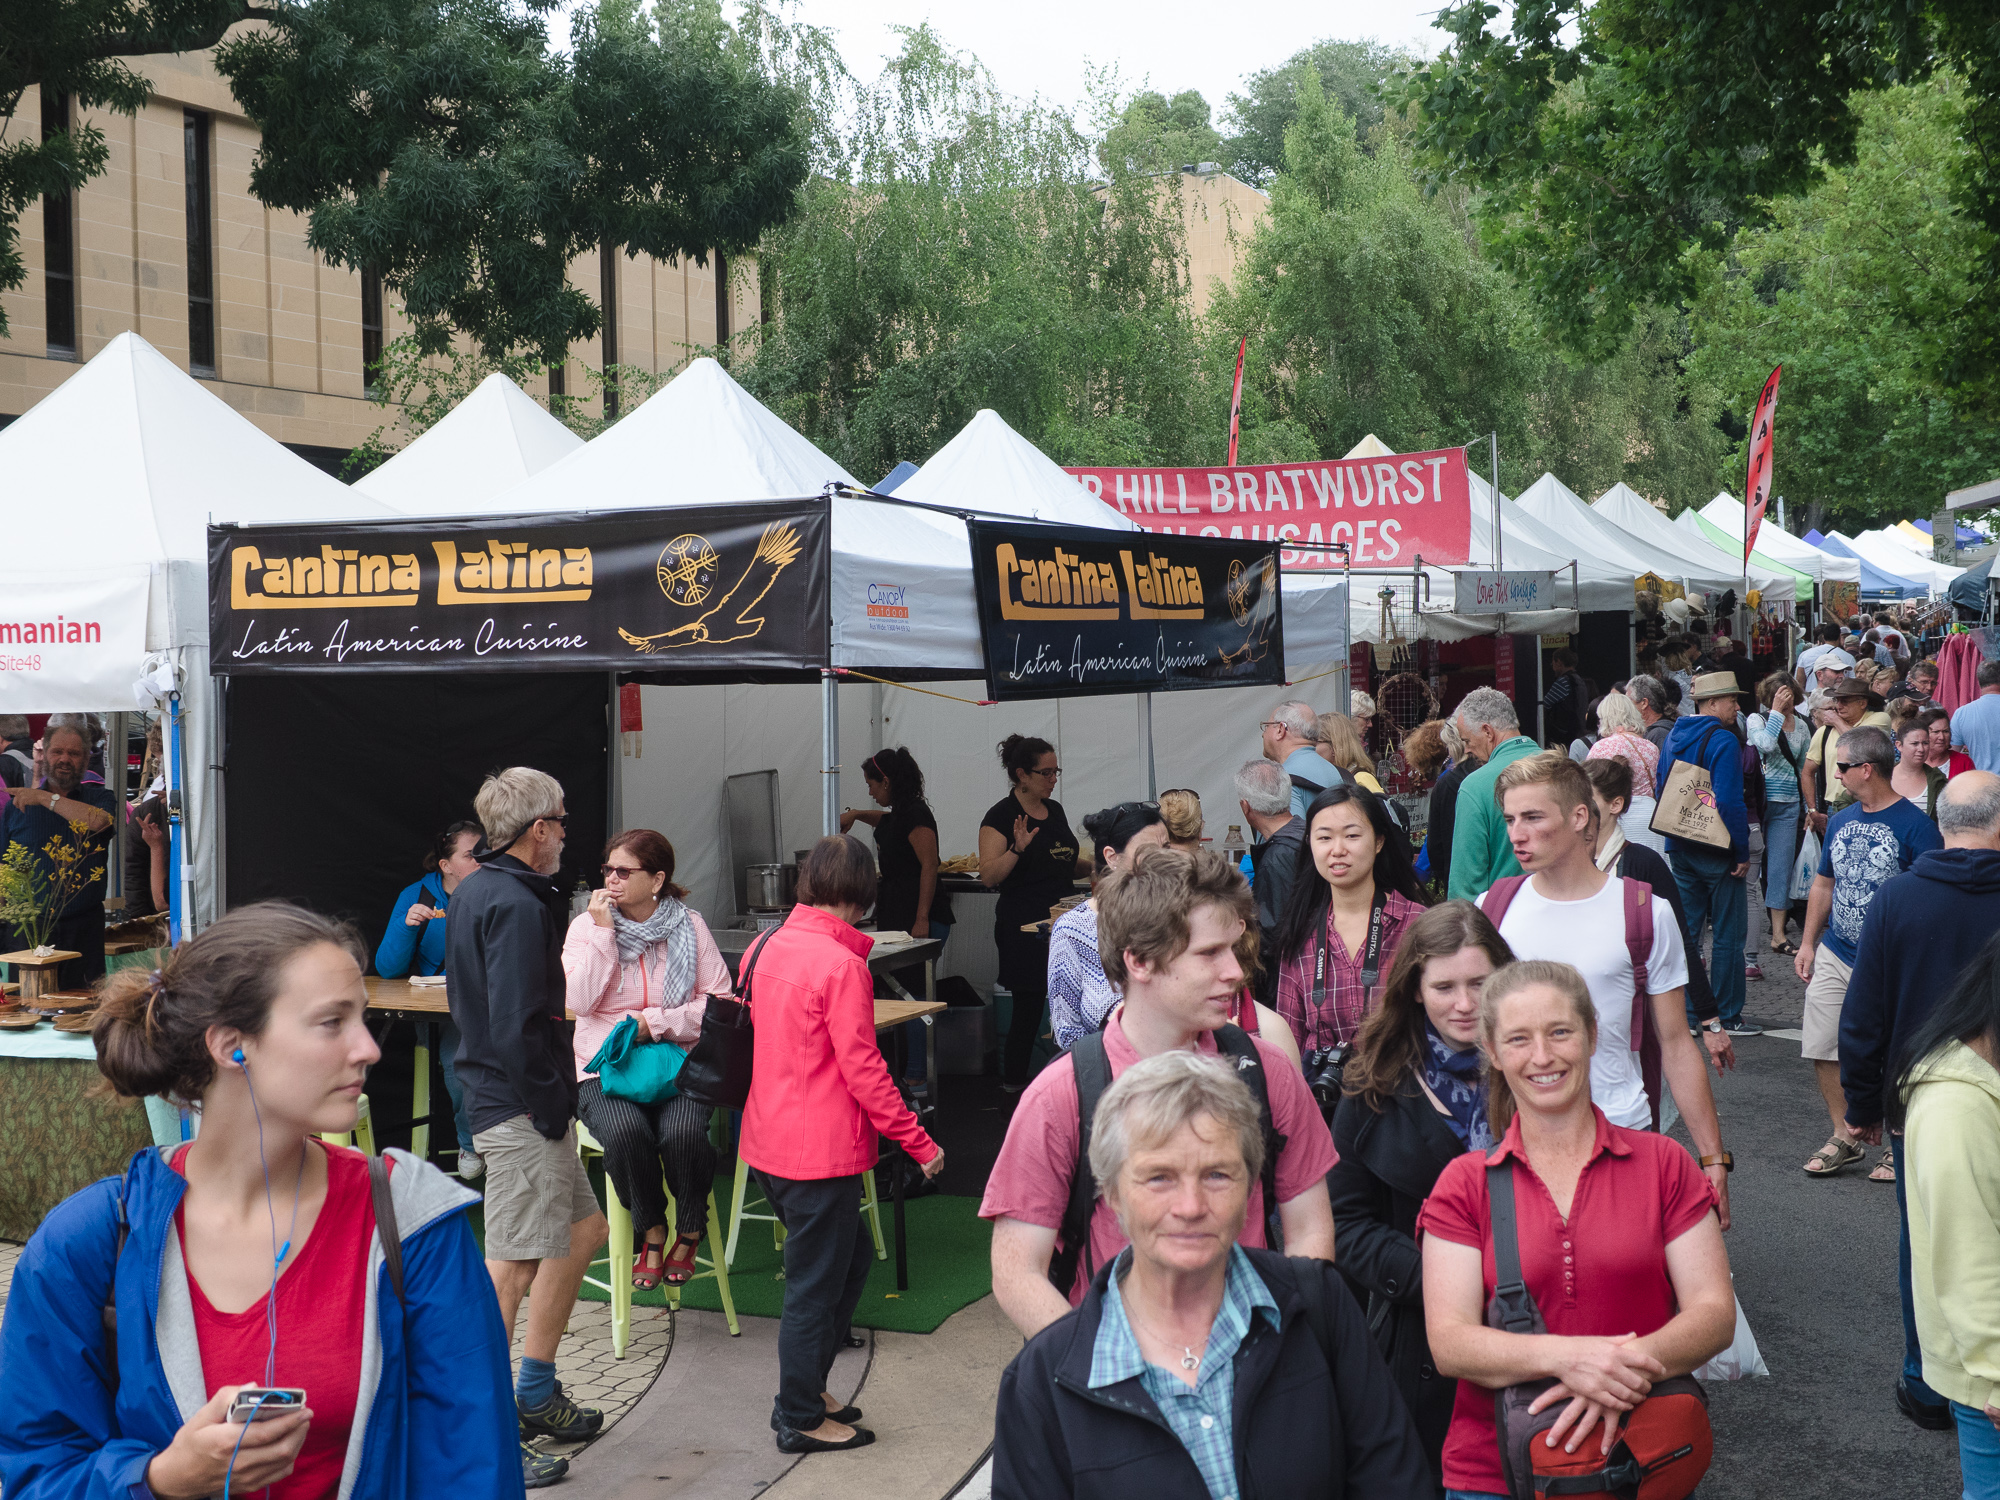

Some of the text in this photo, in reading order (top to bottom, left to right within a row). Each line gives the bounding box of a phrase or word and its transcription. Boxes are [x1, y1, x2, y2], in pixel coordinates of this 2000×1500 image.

[1754, 384, 1775, 508] HATS
[1115, 473, 1200, 514] HILL
[1206, 456, 1448, 514] BRATWURST
[1200, 518, 1402, 565] SAGES
[231, 540, 593, 610] Cantina Latina
[996, 542, 1204, 621] Cantina Latina
[0, 615, 101, 644] manian
[868, 607, 907, 617] outdoor
[232, 618, 588, 662] Latin American Cuisine
[1009, 633, 1208, 683] Latin American Cuisine
[0, 654, 41, 671] Site48
[1679, 779, 1712, 796] Salam
[1679, 806, 1714, 823] Market
[1693, 820, 1708, 829] 1972
[1836, 823, 1893, 847] RUTHLESS
[1369, 907, 1381, 959] EOS DIGITAL
[1316, 948, 1325, 979] Canon
